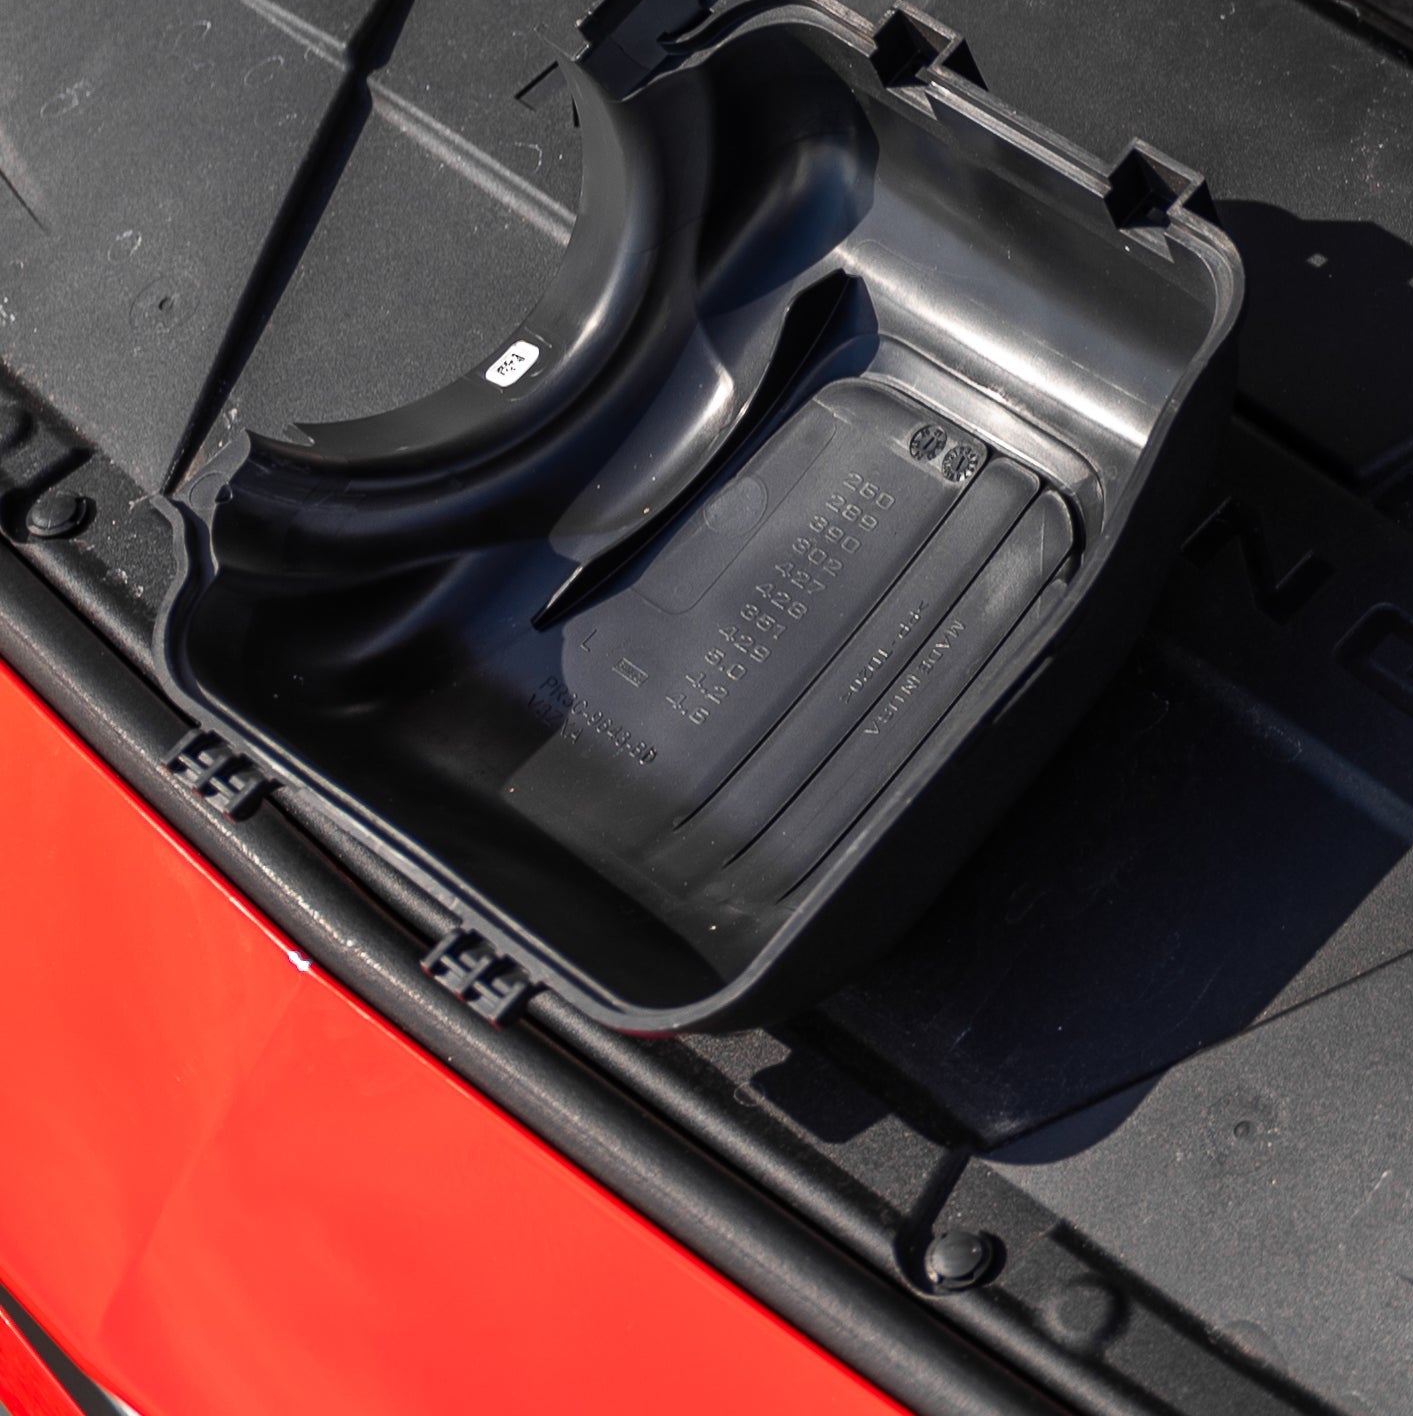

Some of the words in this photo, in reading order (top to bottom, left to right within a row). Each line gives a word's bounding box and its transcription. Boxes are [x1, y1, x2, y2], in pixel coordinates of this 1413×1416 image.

[825, 493, 878, 532] 289
[809, 515, 861, 554] 390
[792, 537, 843, 577] 302
[775, 562, 826, 595] 427
[756, 583, 807, 620] 428
[740, 603, 786, 640] 351
[718, 625, 771, 663] 429
[920, 620, 965, 674] MADE
[704, 648, 746, 681] 5.0
[685, 672, 728, 704] 4.2
